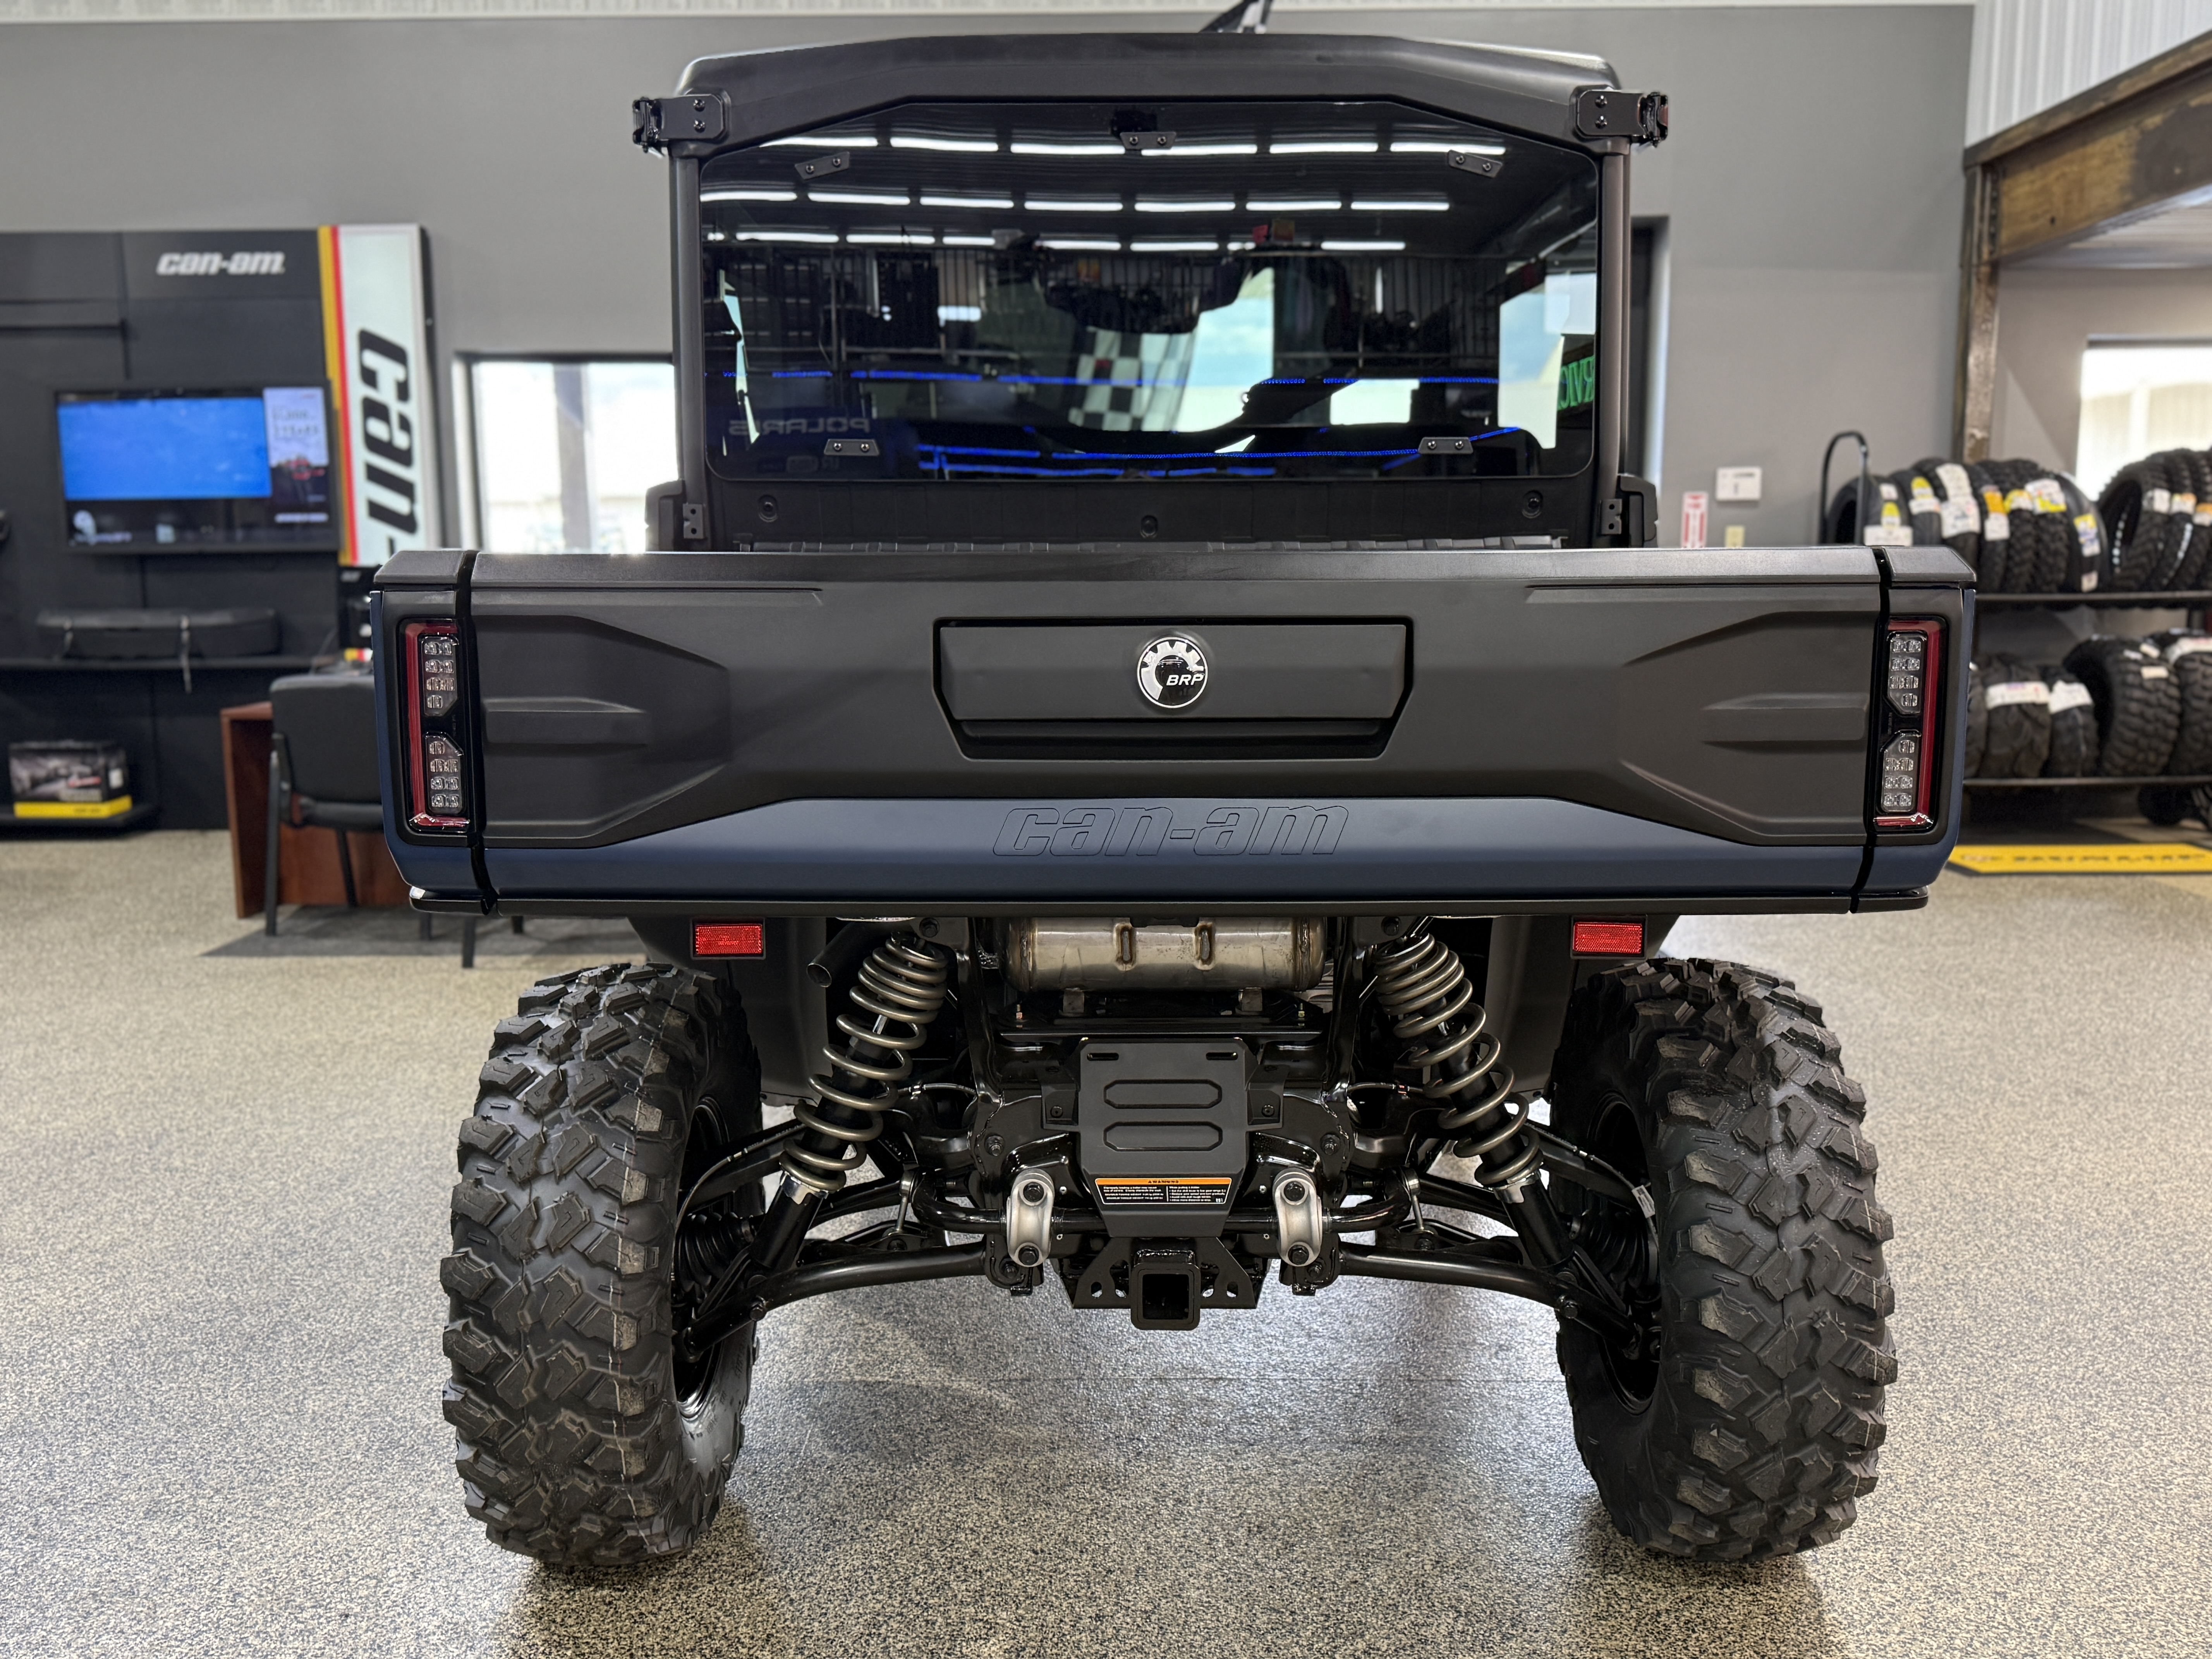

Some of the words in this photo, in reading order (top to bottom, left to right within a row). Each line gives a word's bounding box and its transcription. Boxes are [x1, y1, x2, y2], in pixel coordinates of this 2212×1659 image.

[156, 252, 285, 275] can-am
[1166, 674, 1204, 686] BRP
[993, 806, 1349, 856] can-am
